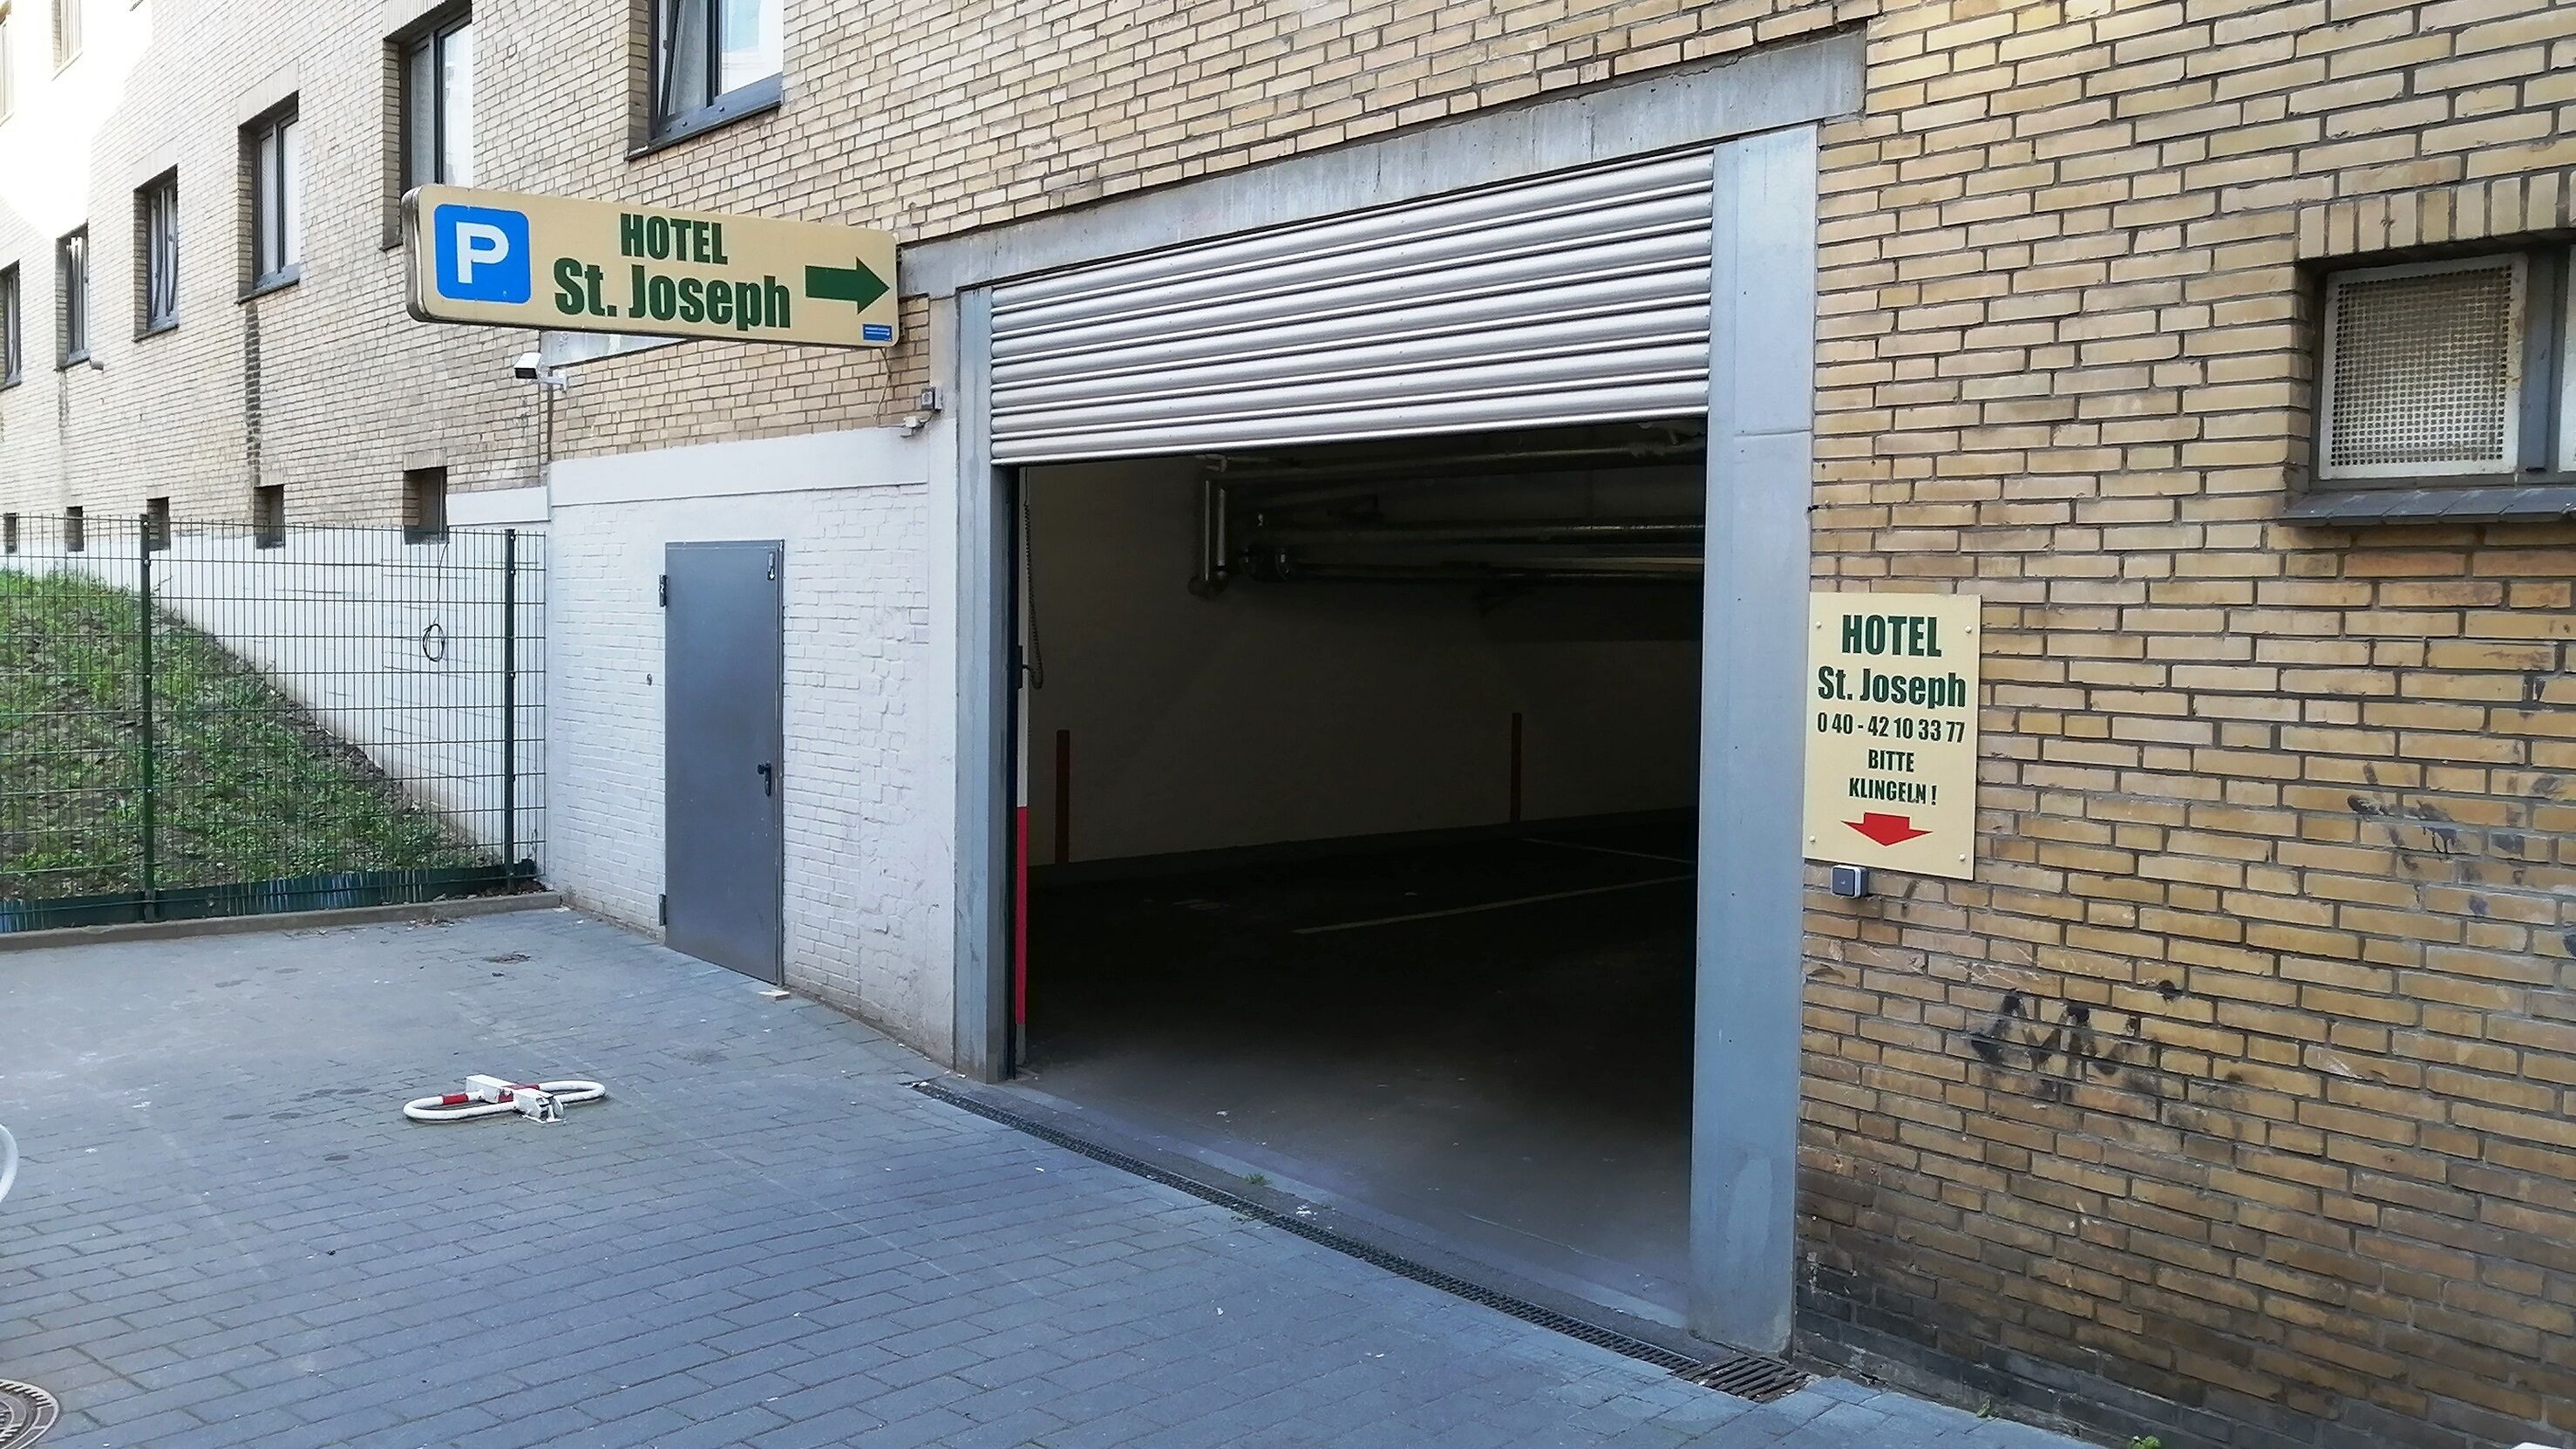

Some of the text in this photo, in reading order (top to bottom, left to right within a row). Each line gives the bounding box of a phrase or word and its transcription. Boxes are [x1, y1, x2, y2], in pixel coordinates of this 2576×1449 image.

[455, 221, 509, 284] P
[621, 213, 727, 265] HOTEL
[554, 258, 791, 331] St. Joseph
[1842, 615, 1942, 656] HOTEL
[1818, 665, 1966, 709] St. Joseph
[1868, 749, 1914, 772] BITTE
